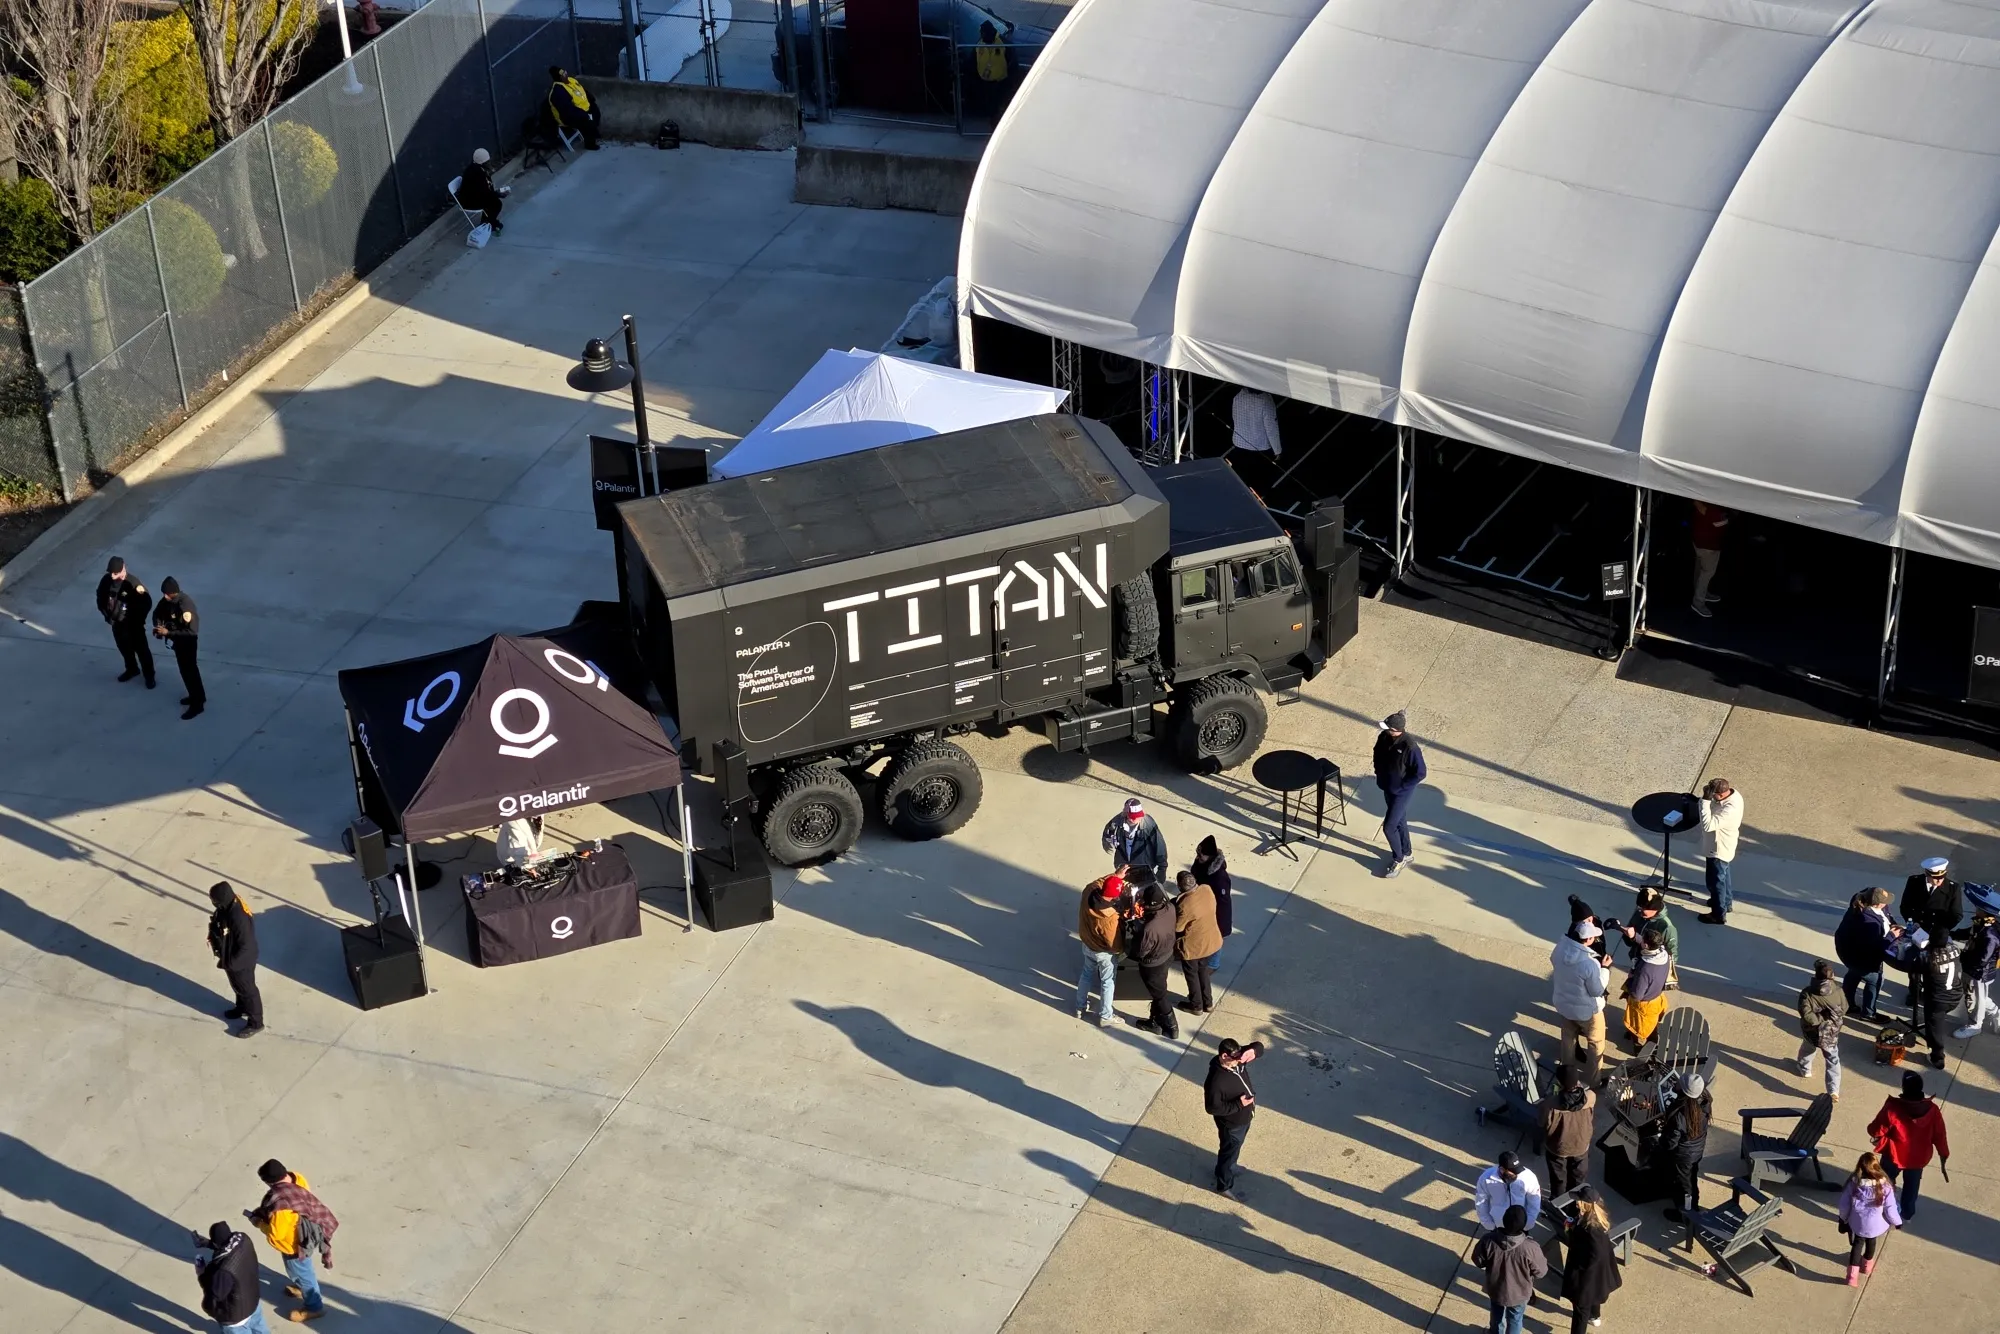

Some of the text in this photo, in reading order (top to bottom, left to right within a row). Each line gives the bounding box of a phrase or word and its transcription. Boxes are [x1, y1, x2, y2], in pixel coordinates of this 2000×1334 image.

[604, 482, 636, 493] Palantir
[823, 543, 1108, 663] TITAN
[736, 641, 783, 658] PALANTIR
[737, 666, 778, 682] The Proud
[738, 665, 814, 689] Software Partner Of
[751, 674, 815, 694] America's Game
[520, 783, 590, 812] Palantir
[1940, 961, 1955, 991] 7
